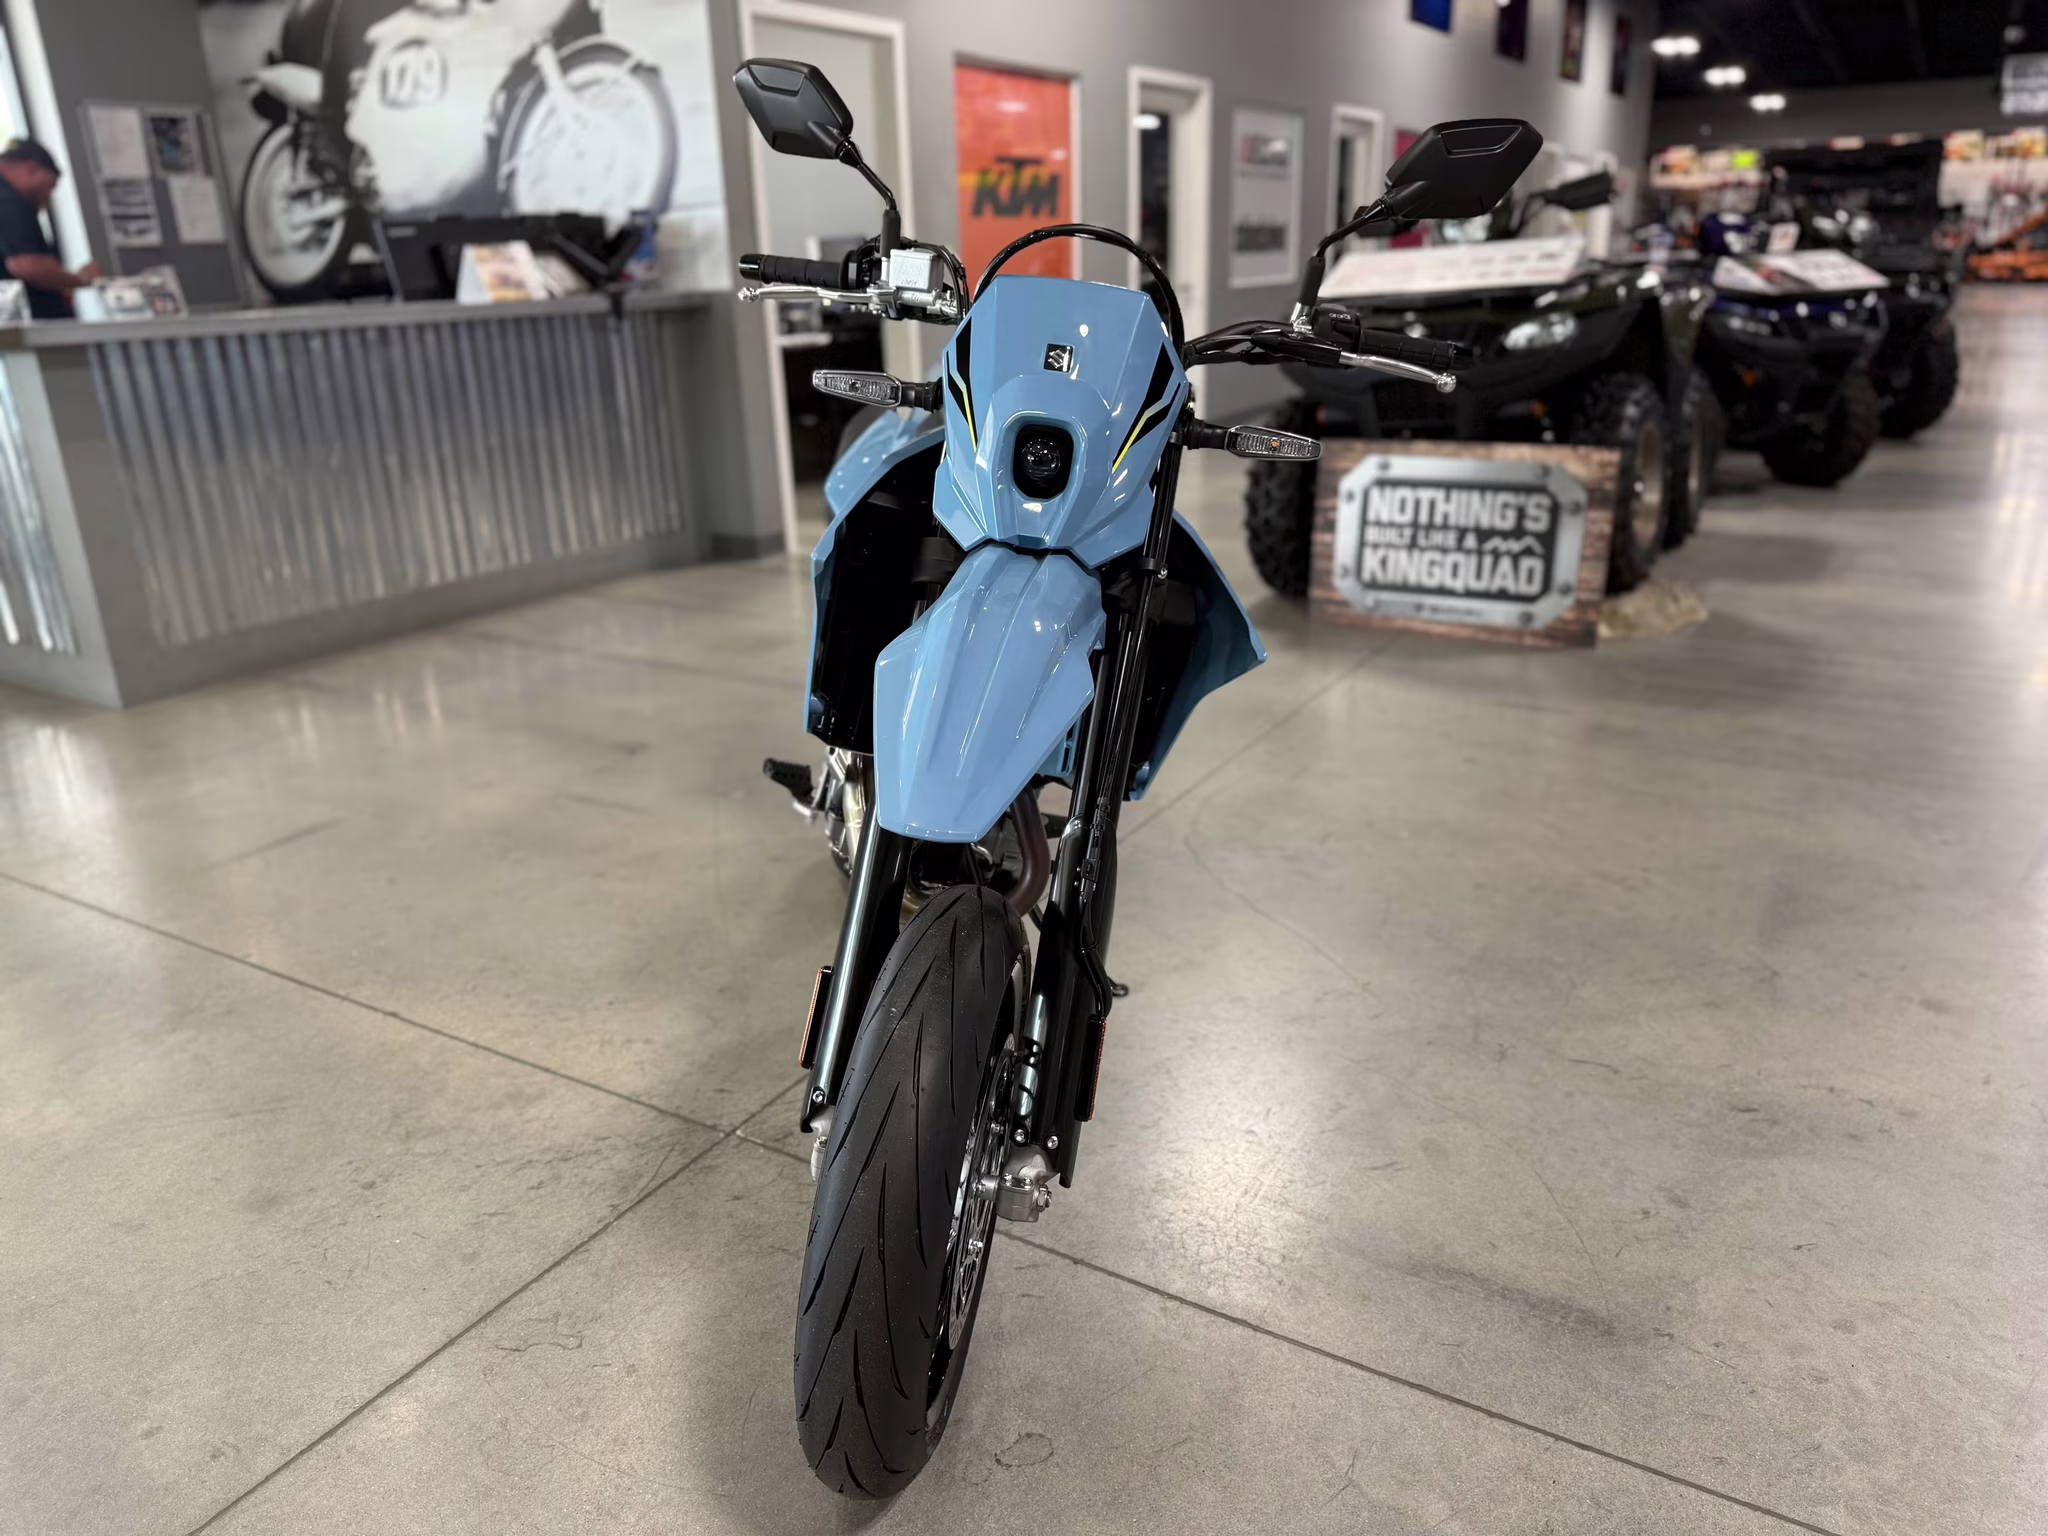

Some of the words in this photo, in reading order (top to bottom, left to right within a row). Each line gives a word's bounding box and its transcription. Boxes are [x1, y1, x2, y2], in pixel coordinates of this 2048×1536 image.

[971, 155, 1061, 218] KTM
[1367, 486, 1552, 532] NOTHING'S
[1363, 525, 1413, 547] BUILT
[1416, 527, 1460, 549] LIKE
[1461, 530, 1479, 550] A
[1362, 546, 1545, 595] KINGQUAD
